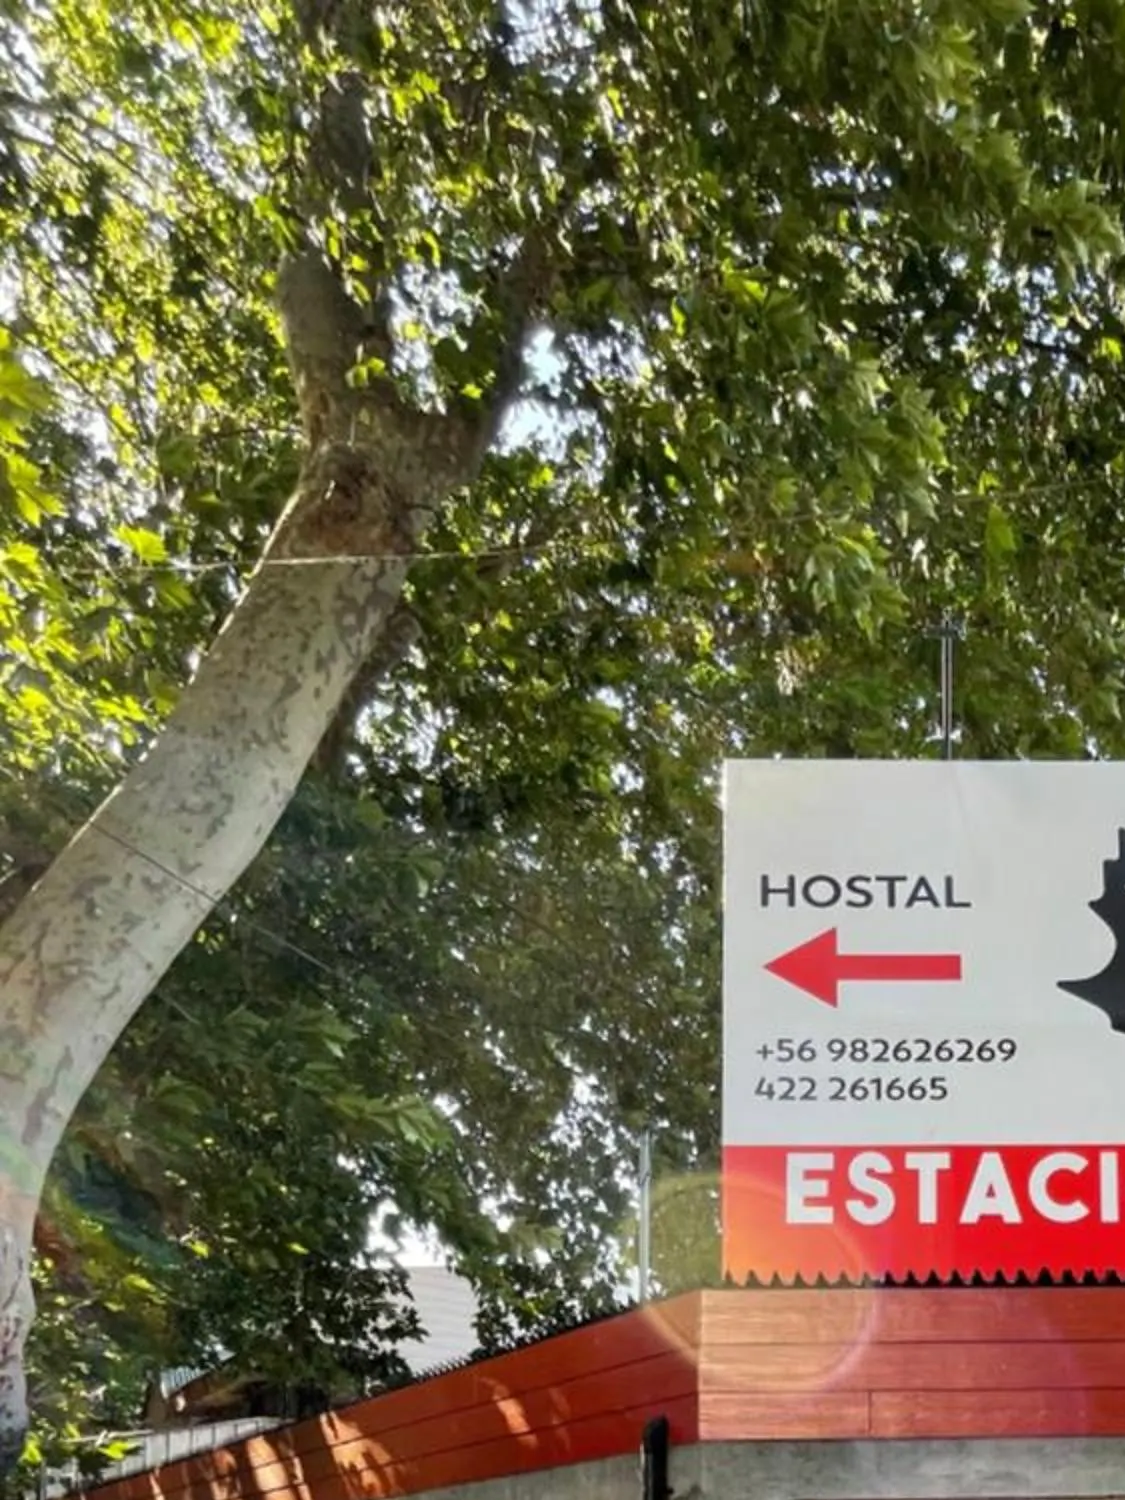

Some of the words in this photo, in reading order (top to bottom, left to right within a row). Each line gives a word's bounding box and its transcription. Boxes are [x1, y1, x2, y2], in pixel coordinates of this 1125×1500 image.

[759, 874, 972, 909] HOSTAL
[755, 1038, 818, 1064] +56
[827, 1038, 1017, 1064] 982626269
[754, 1076, 818, 1102] 422
[828, 1076, 949, 1102] 261665
